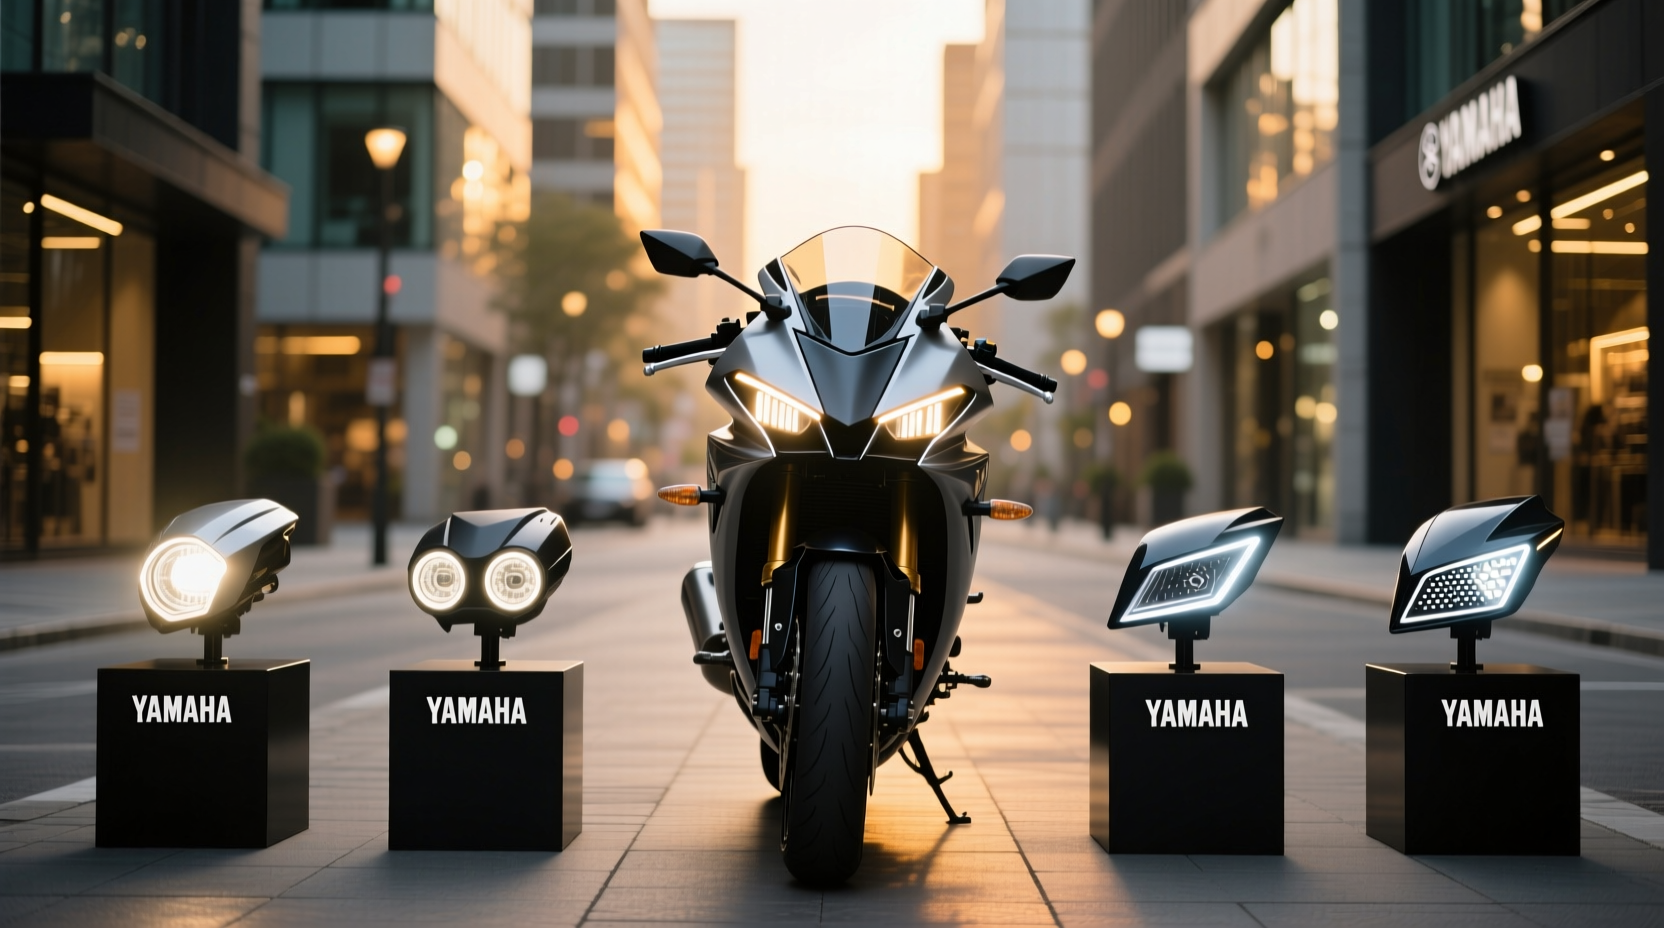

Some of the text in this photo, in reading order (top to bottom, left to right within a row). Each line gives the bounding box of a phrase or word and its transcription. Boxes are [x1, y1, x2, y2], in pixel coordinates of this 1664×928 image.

[1438, 75, 1522, 179] YAMAHA
[132, 695, 231, 723] YAMAHA
[427, 697, 526, 724] YAMAHA
[1146, 700, 1248, 727] YAMAHA
[1442, 700, 1543, 727] YAMAHA
